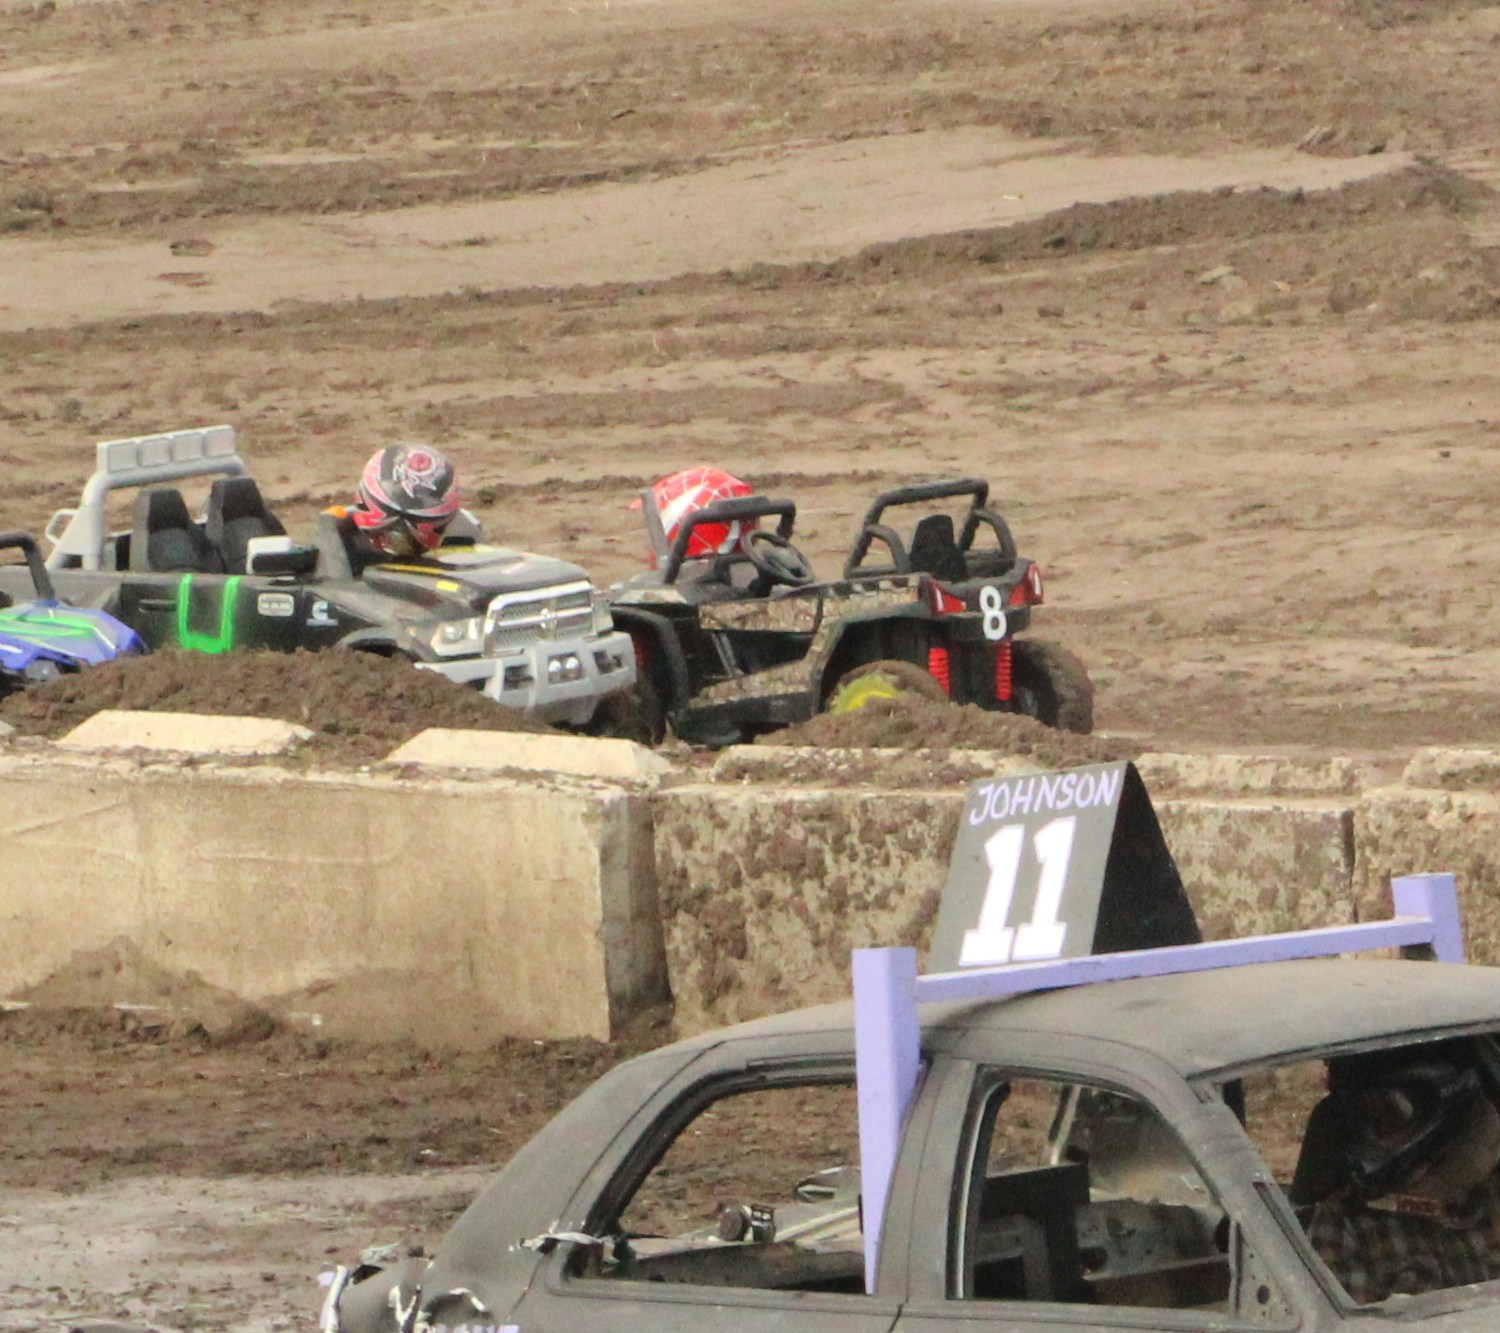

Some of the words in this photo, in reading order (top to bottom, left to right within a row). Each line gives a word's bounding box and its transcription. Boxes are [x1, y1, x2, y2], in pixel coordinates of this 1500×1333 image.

[979, 585, 1008, 641] 8
[968, 768, 1122, 826] JOHNSON
[958, 815, 1077, 967] 11
